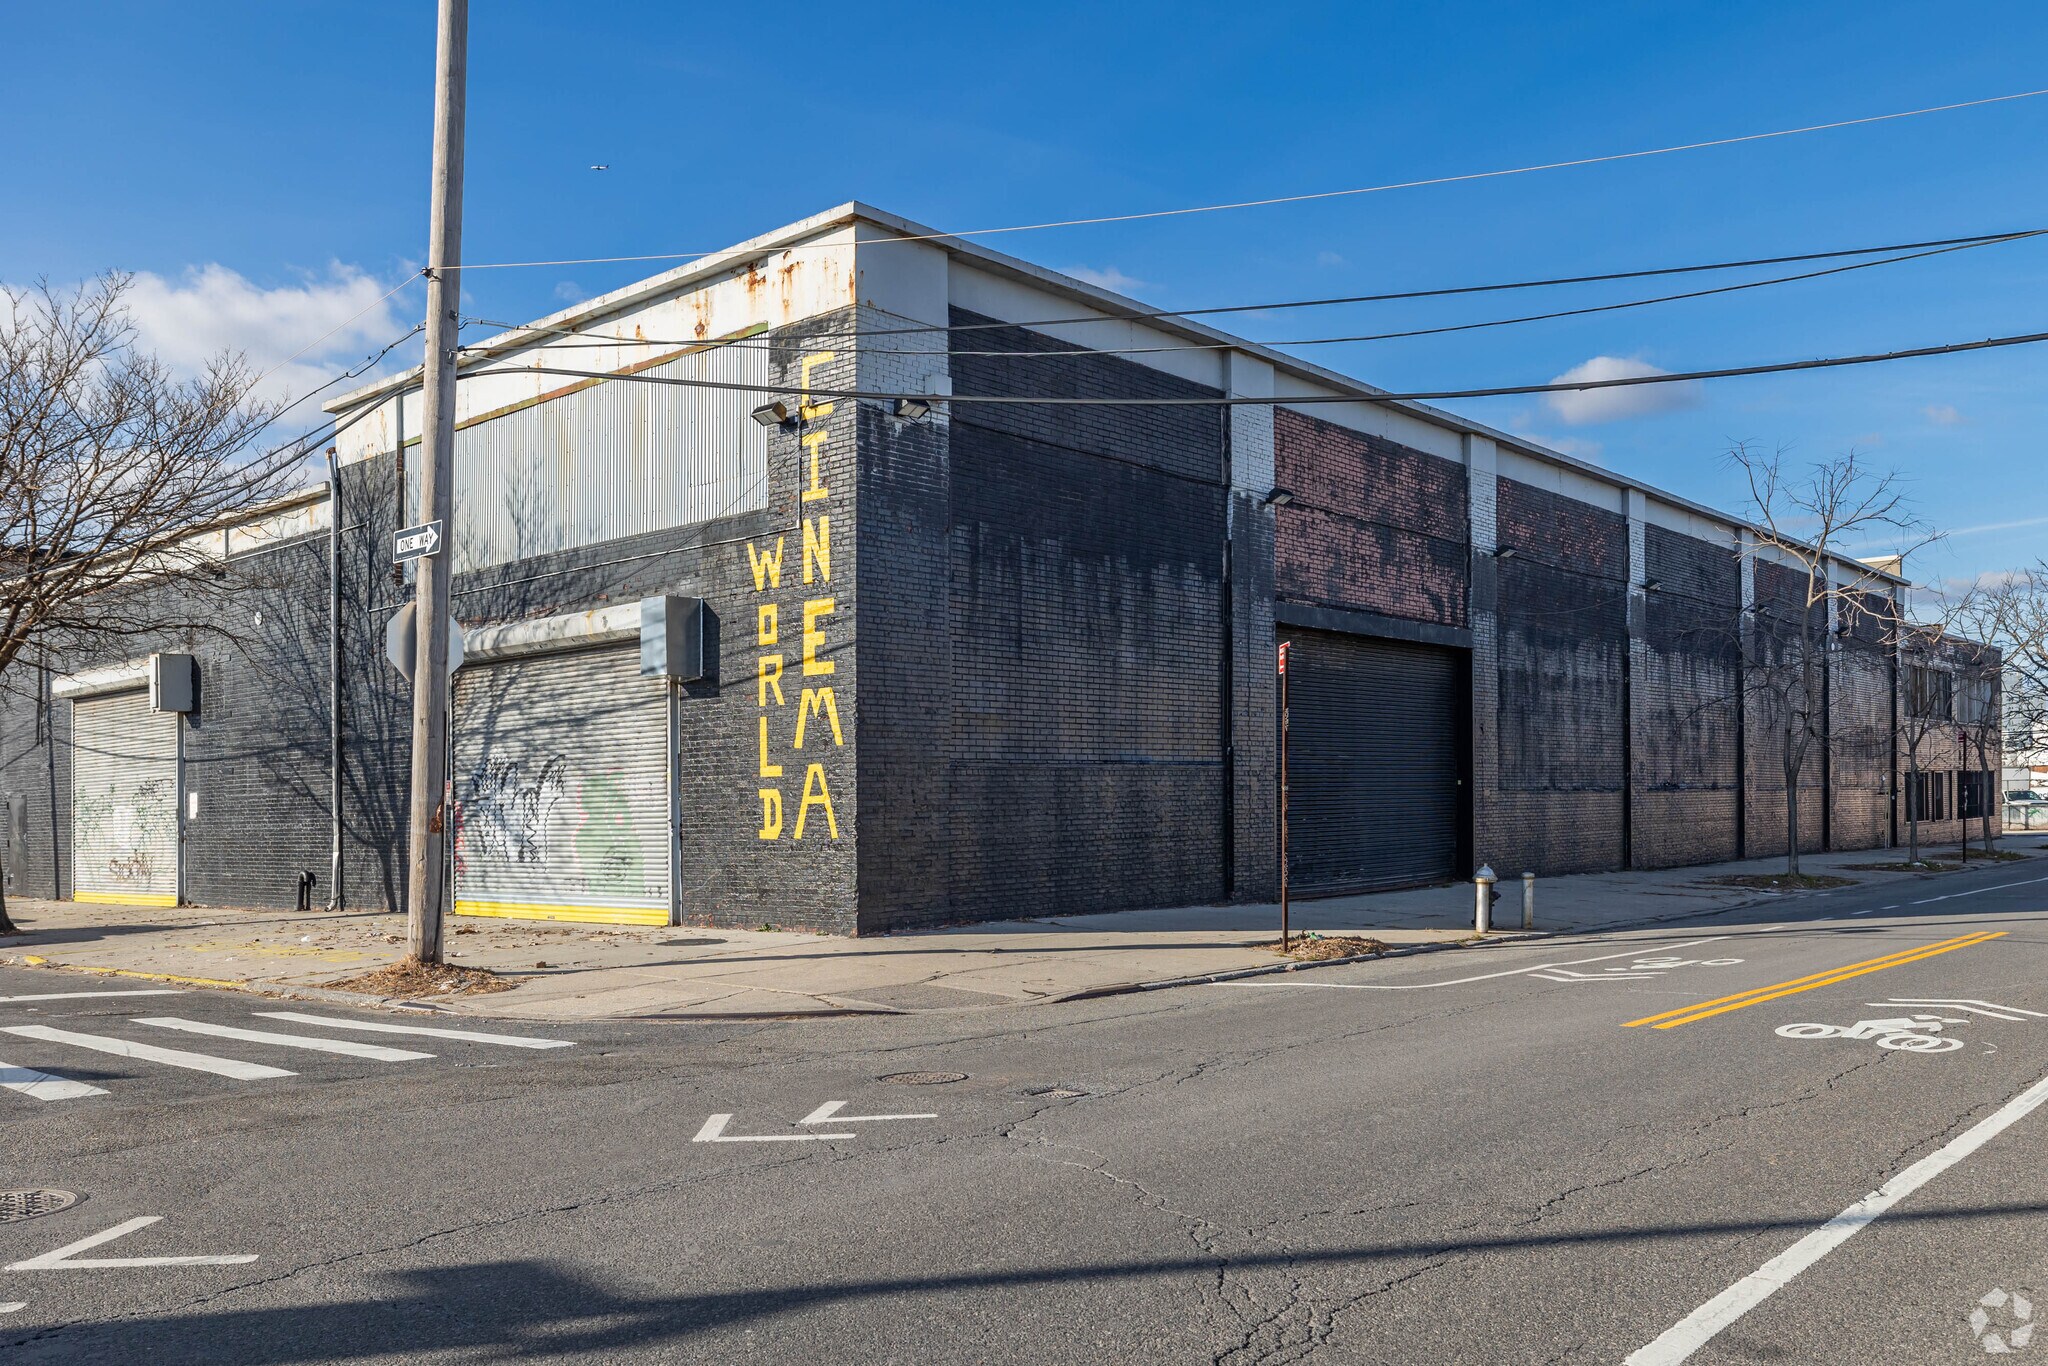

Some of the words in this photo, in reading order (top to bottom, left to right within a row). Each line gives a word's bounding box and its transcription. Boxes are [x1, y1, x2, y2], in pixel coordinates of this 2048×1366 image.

[400, 537, 414, 551] ONE
[419, 533, 433, 546] WAY
[747, 536, 785, 840] WORLD
[794, 351, 844, 840] CINEMA
